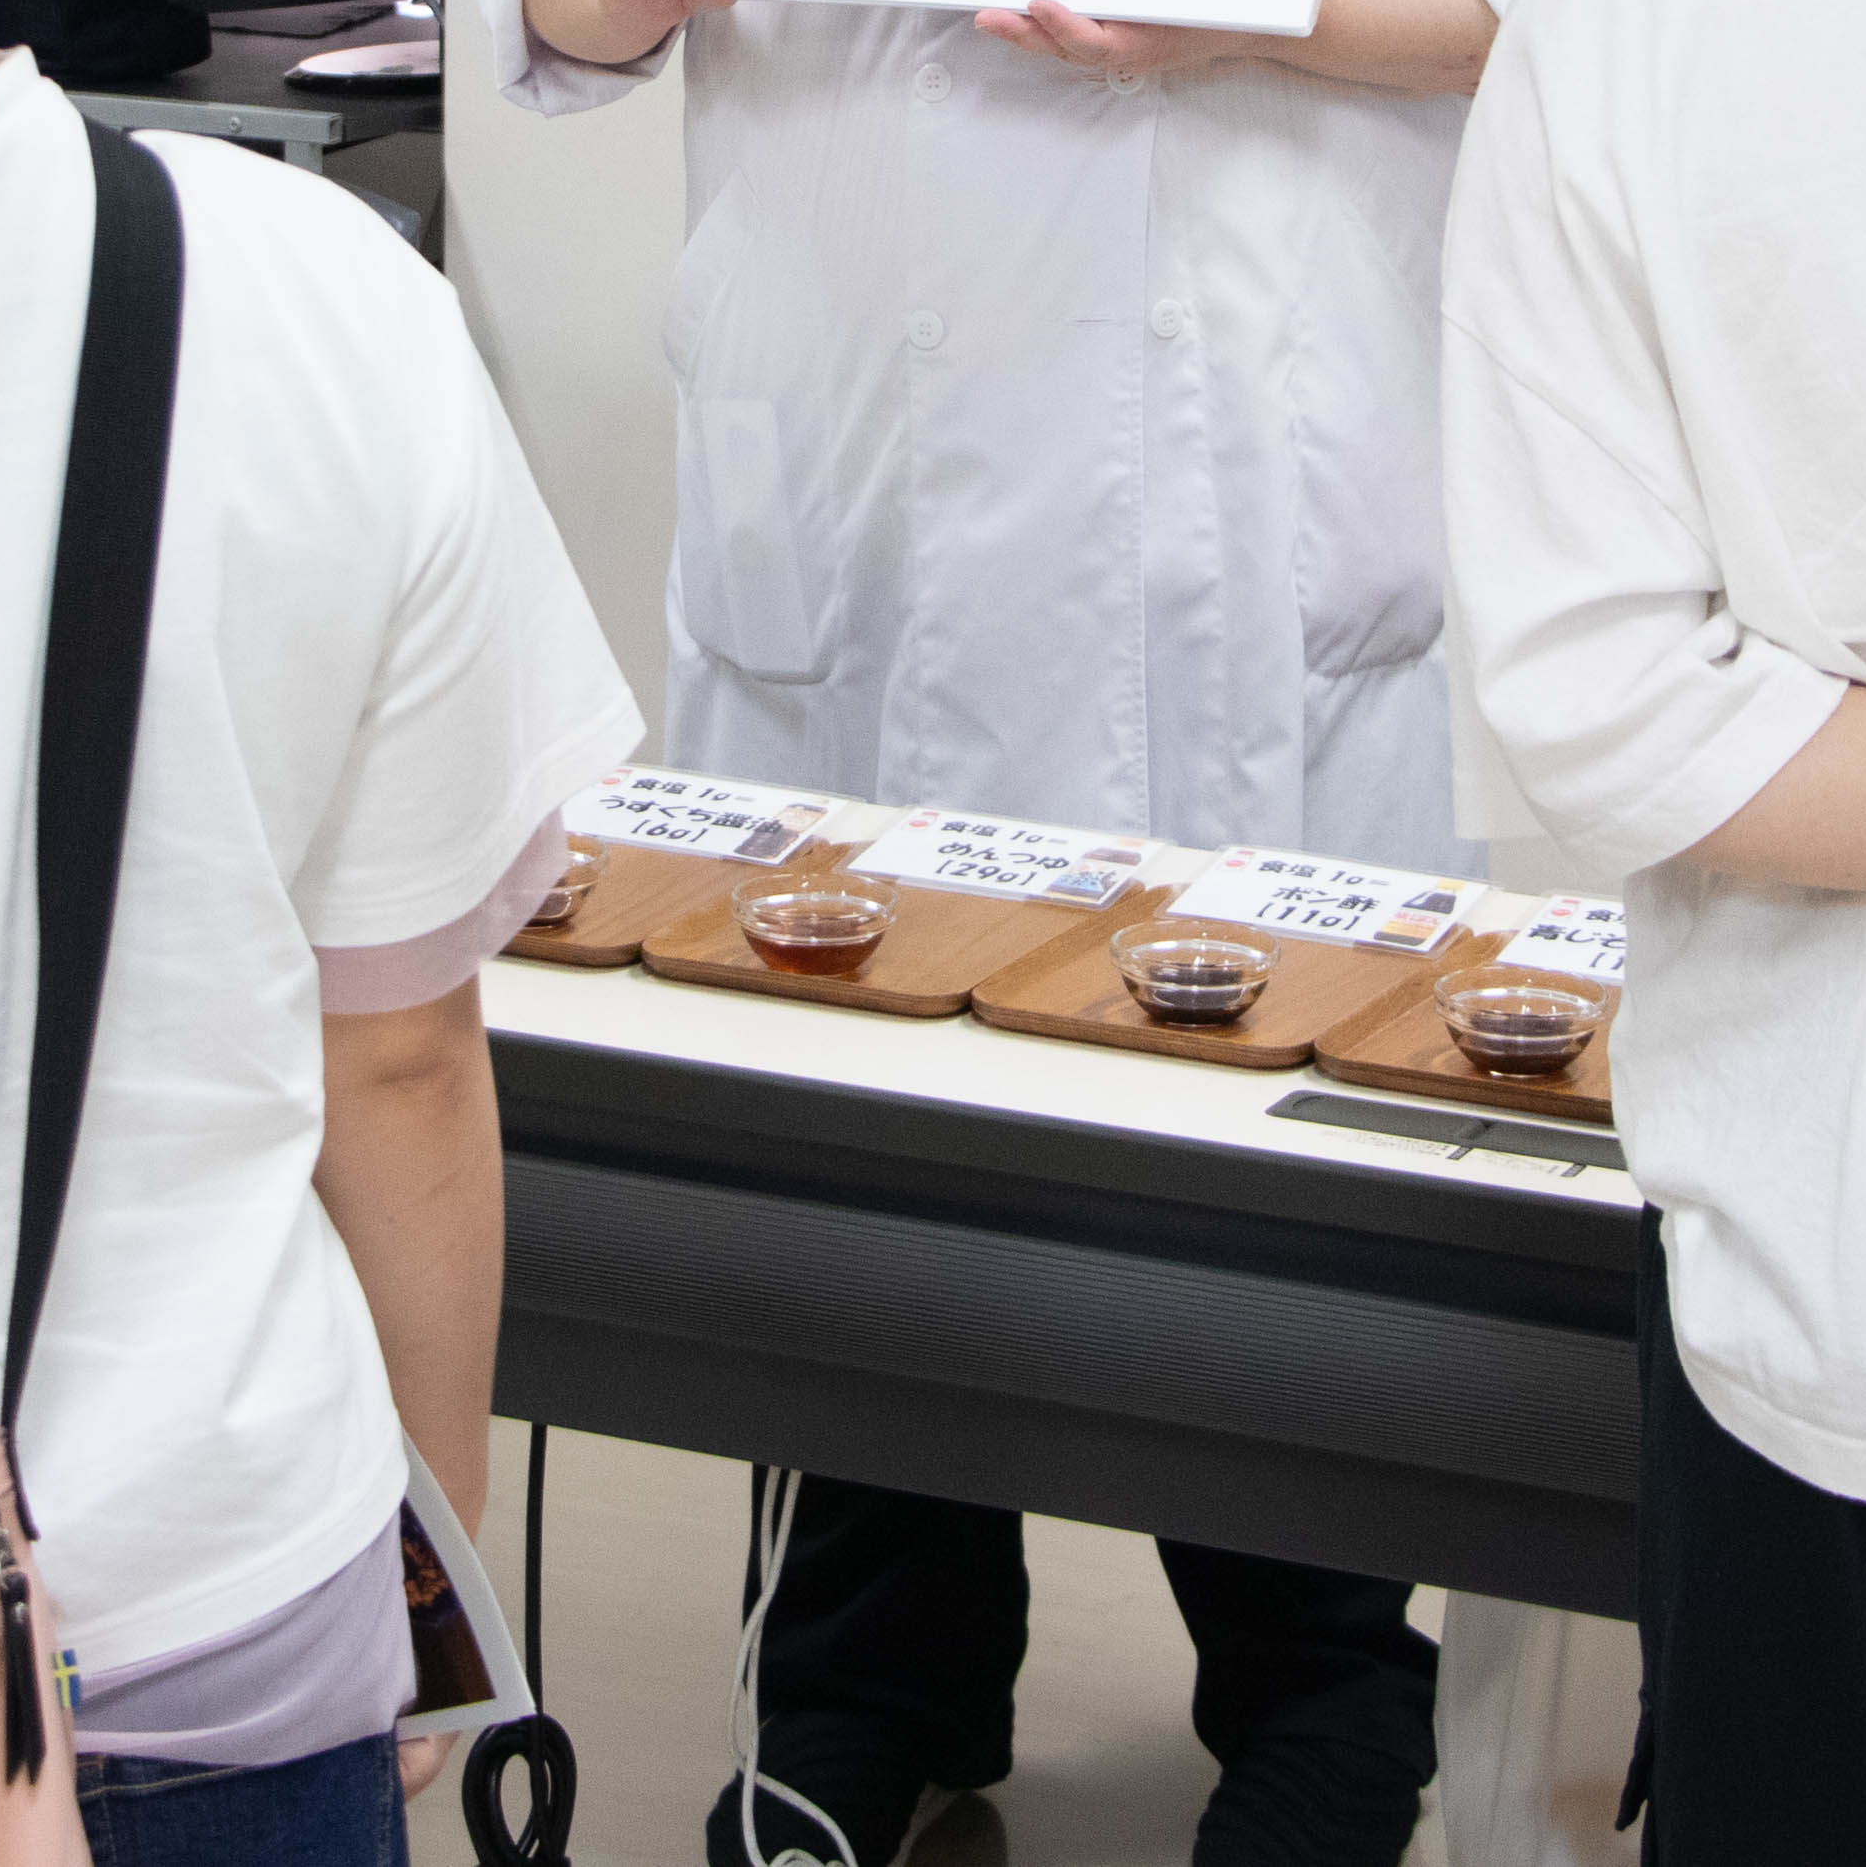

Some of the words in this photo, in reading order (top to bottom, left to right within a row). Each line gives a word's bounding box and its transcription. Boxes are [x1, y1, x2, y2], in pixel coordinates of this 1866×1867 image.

[937, 842, 1071, 870] めんつゆ
[1271, 886, 1381, 912] ポン酢
